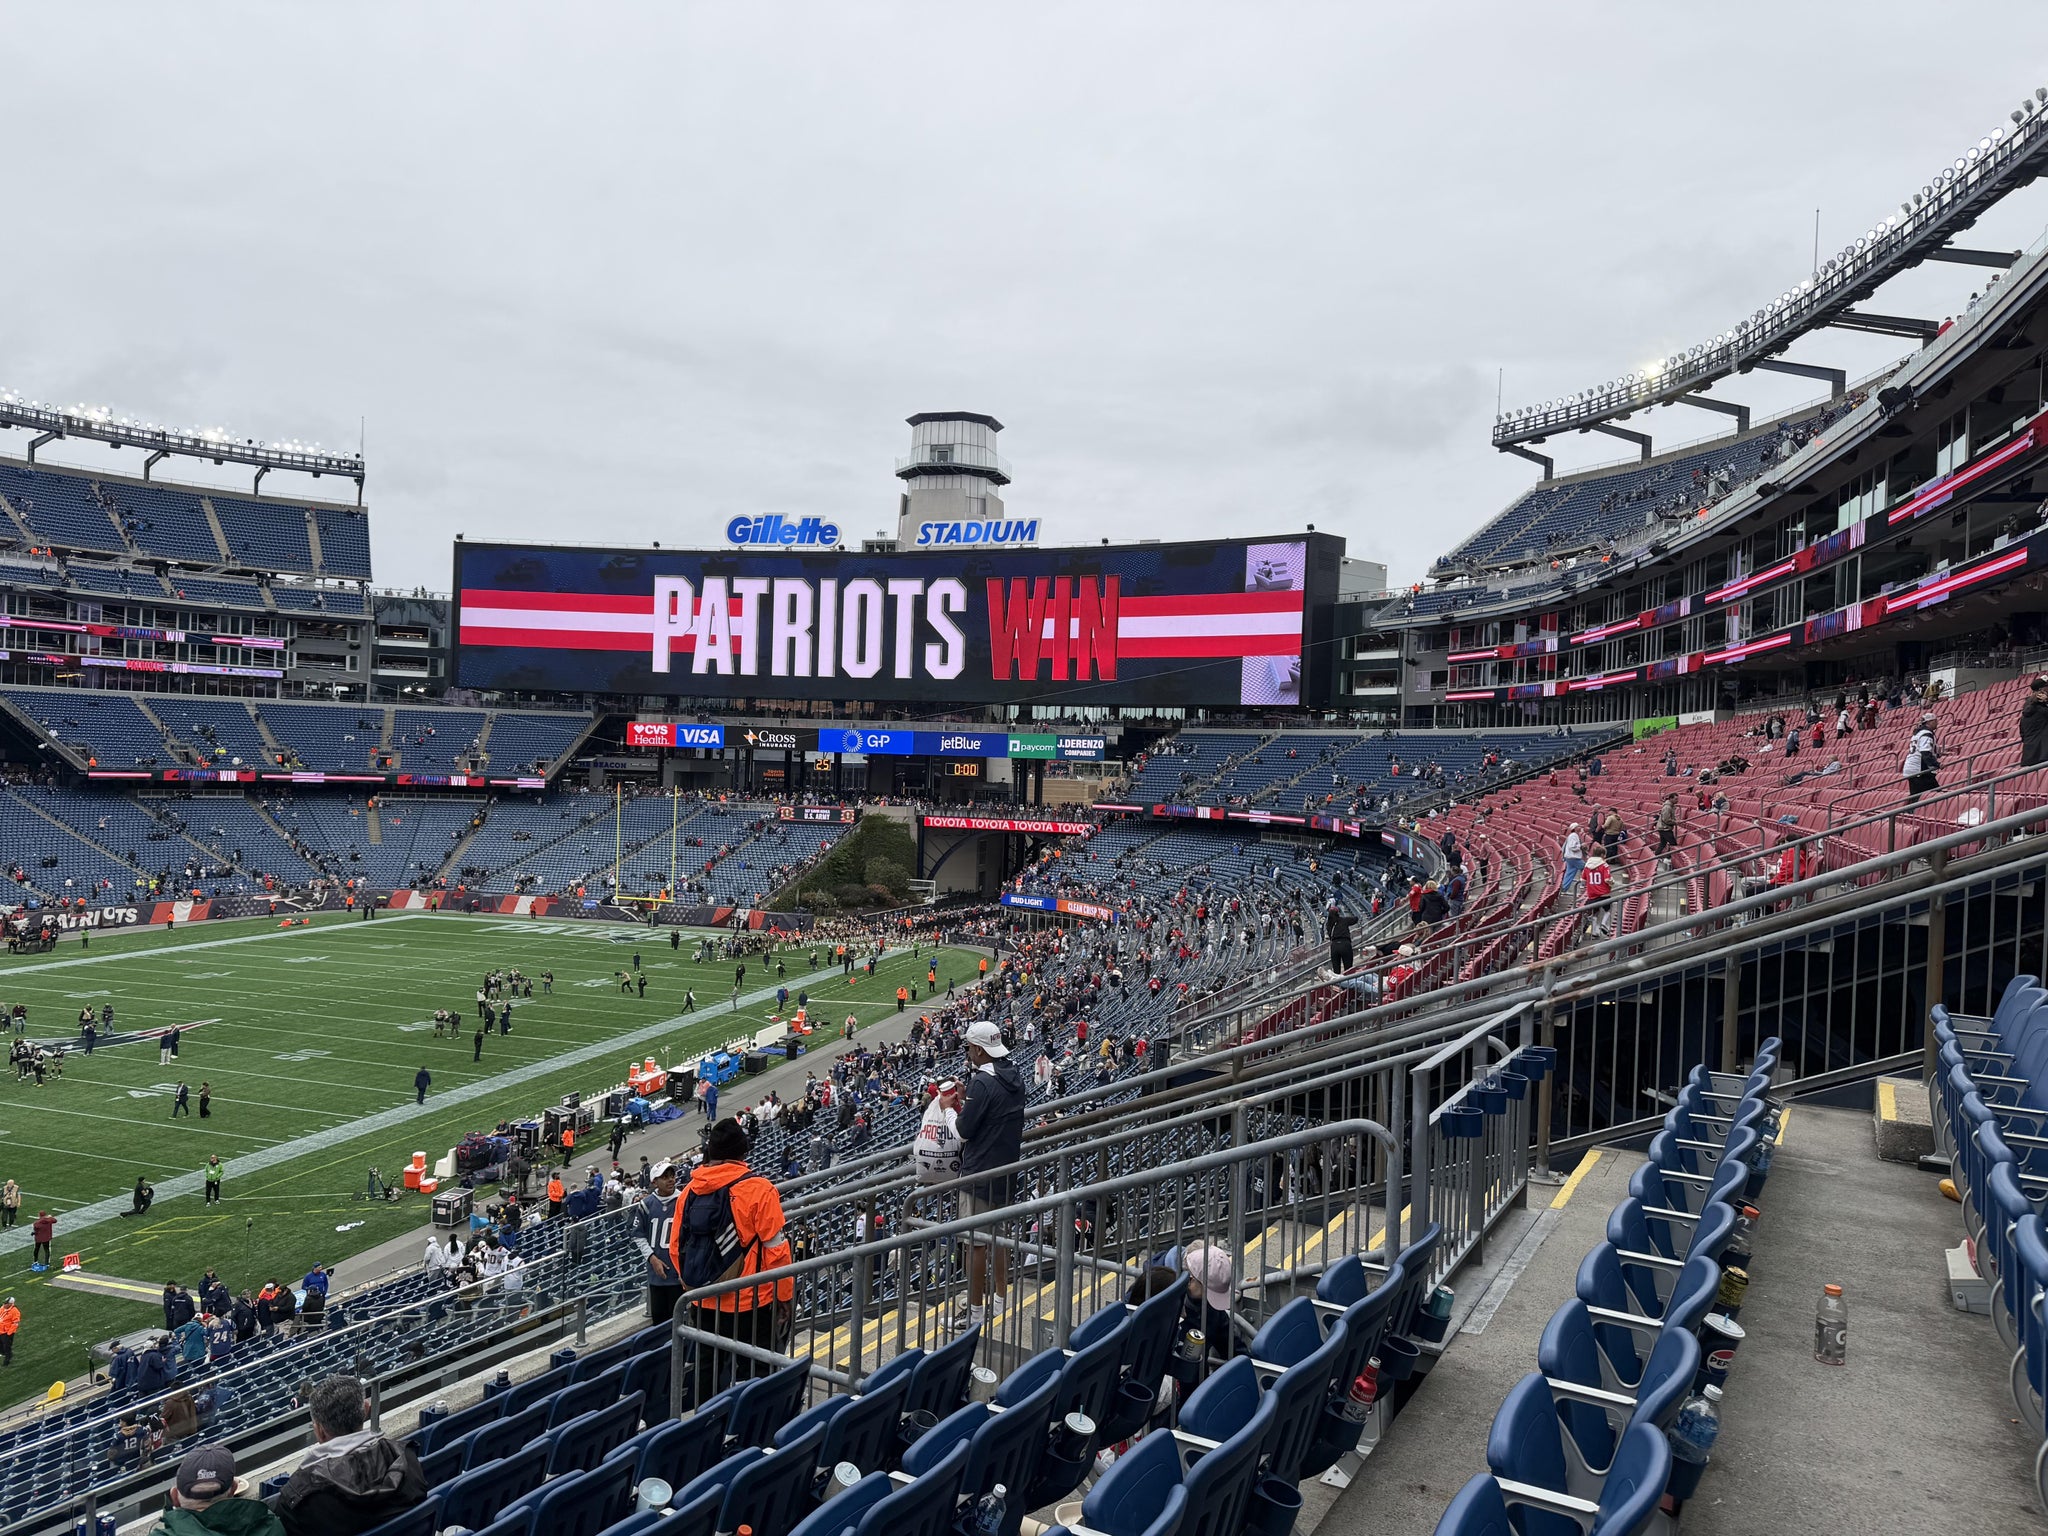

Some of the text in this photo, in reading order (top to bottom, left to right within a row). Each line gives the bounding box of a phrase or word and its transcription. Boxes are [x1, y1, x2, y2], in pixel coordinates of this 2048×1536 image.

[727, 515, 1038, 545] Gillette STADIUM
[652, 574, 1121, 680] PATRIOTS WIN
[165, 631, 185, 642] WIN
[645, 725, 668, 735] CVS
[680, 728, 720, 744] VISA
[940, 736, 981, 751] jetBlue
[1020, 744, 1054, 753] paycom
[1057, 739, 1104, 749] J.DERENZO
[1064, 749, 1096, 757] COMPANIES
[815, 759, 829, 770] 25
[954, 763, 977, 776] 0:00
[219, 770, 237, 781] WIN
[451, 775, 467, 786] WIN
[928, 817, 967, 828] TOYOTA
[970, 818, 1010, 830] TOYOTA
[1013, 820, 1054, 831] TOYOTA
[1588, 871, 1602, 885] 10
[1010, 896, 1043, 907] BUD LIGHT
[650, 1217, 675, 1249] 10
[66, 1254, 79, 1266] 20
[213, 1331, 228, 1344] 24
[124, 1437, 138, 1450] 12
